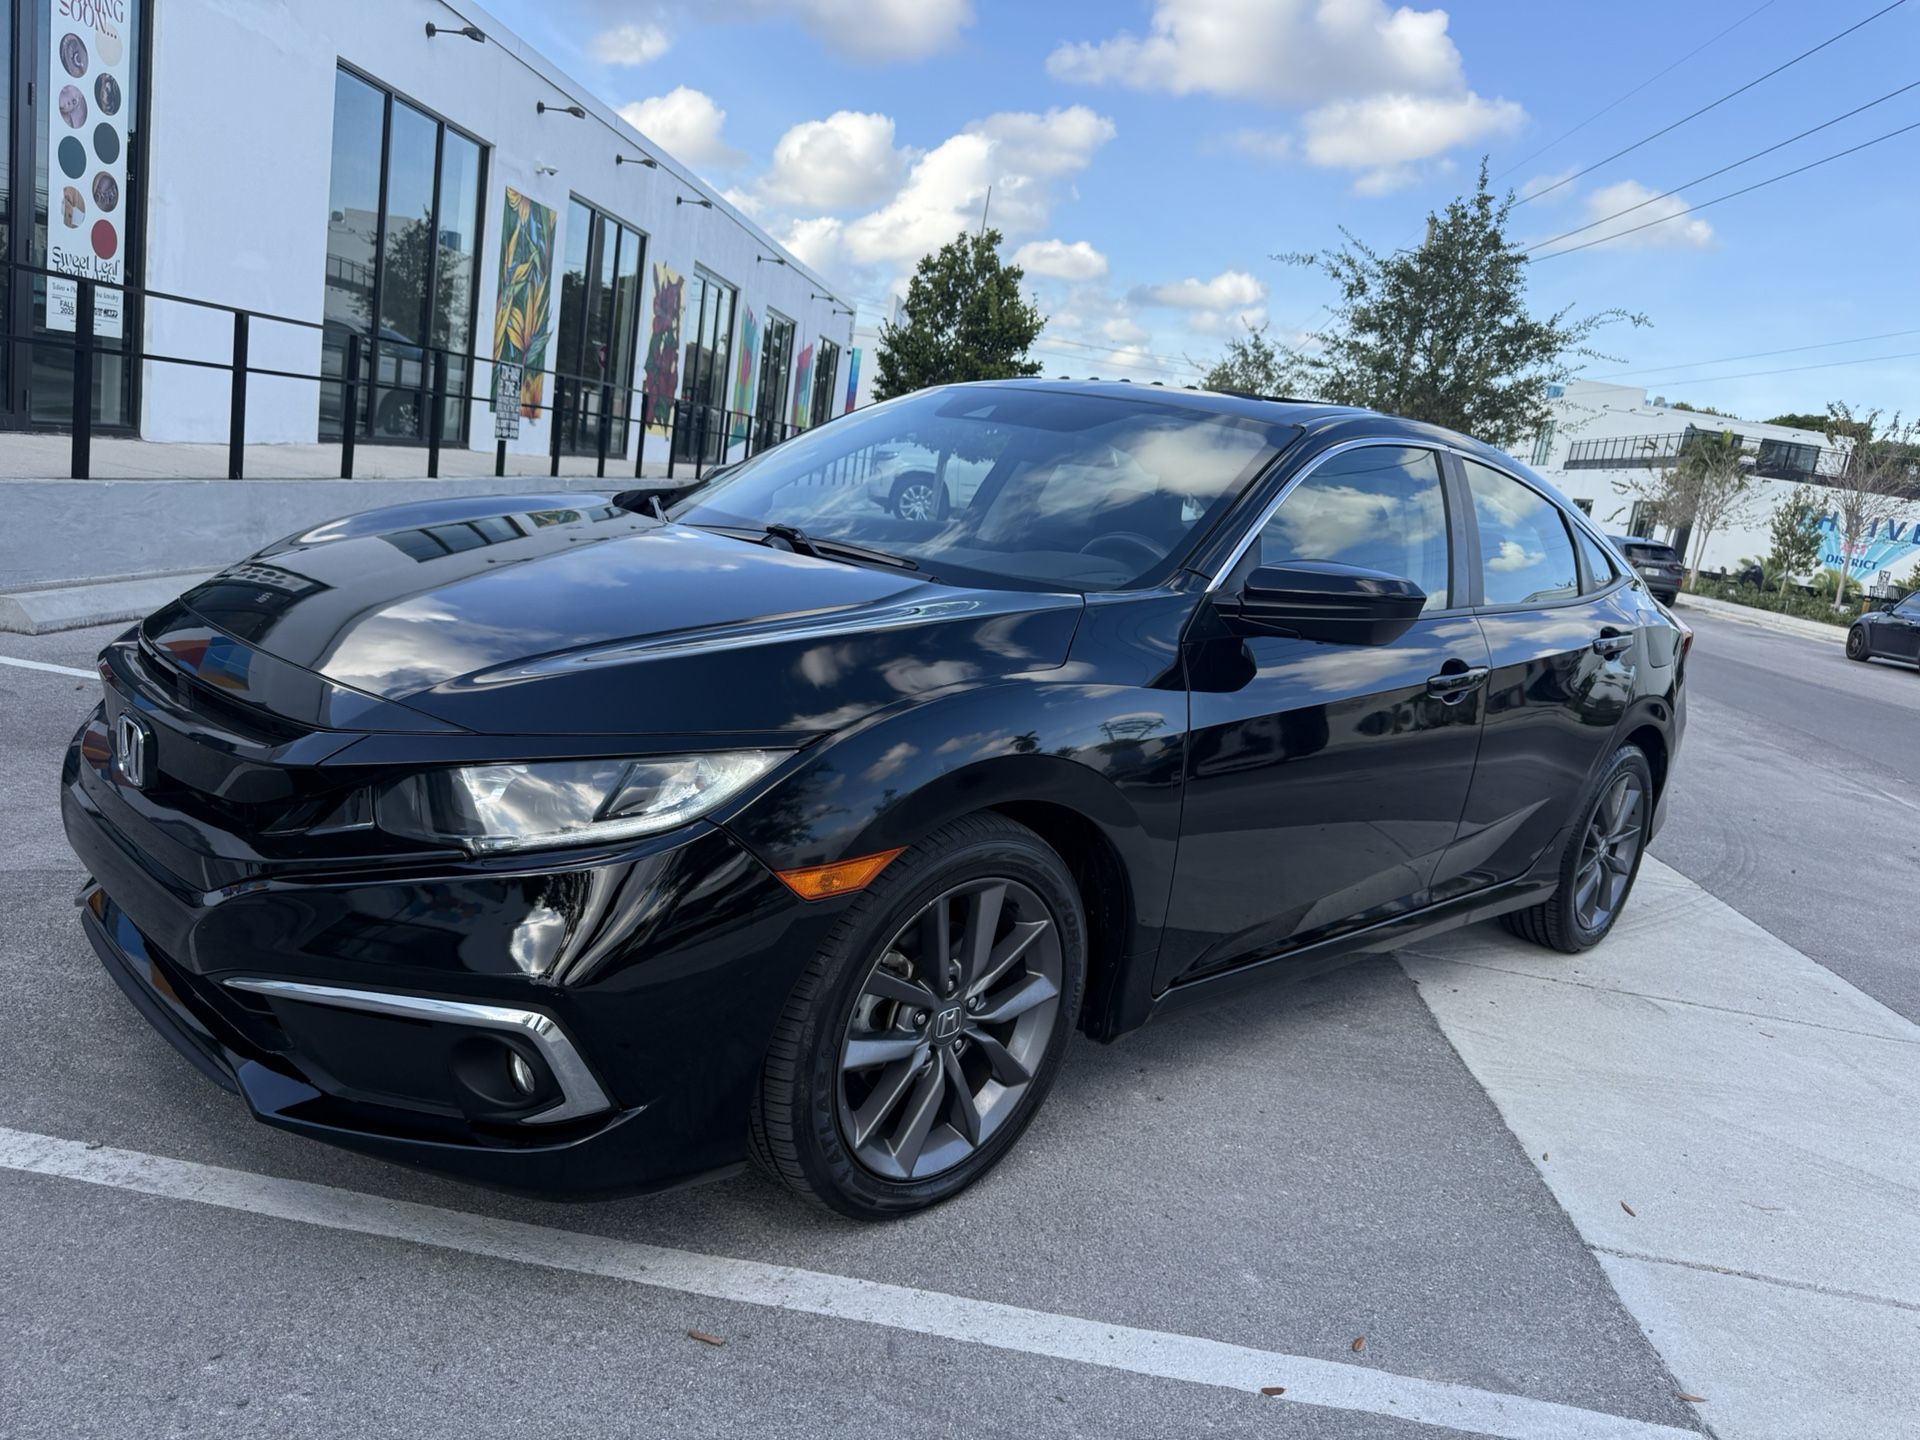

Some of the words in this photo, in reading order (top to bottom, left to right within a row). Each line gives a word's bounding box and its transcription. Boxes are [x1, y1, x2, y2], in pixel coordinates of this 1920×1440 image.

[52, 246, 89, 270] Sweet
[95, 255, 120, 276] Leaf
[1826, 554, 1879, 570] DISRICT
